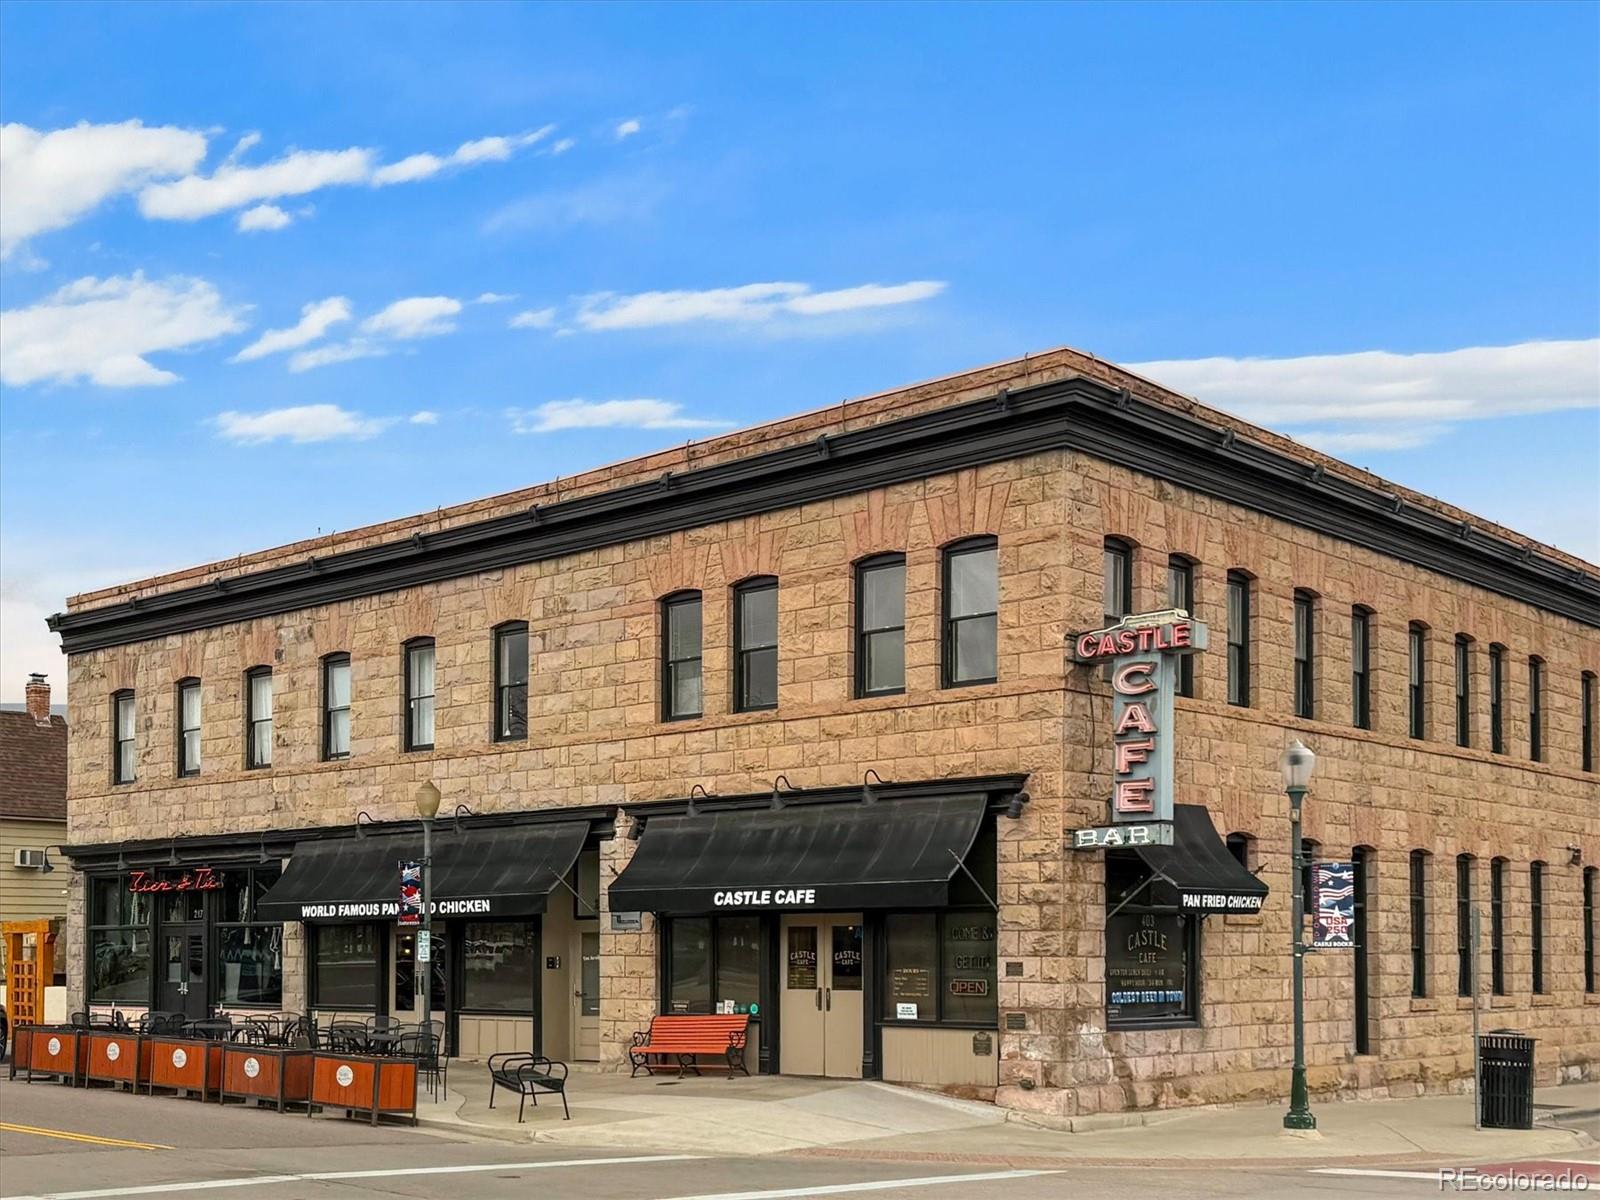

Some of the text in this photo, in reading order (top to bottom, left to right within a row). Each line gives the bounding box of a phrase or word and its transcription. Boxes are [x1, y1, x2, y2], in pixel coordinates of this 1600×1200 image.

[1077, 621, 1191, 658] CASTLE
[1112, 661, 1158, 813] CAFE
[1075, 825, 1151, 847] BAR
[713, 889, 816, 906] CASTLE CAFE
[1182, 894, 1262, 909] PAN FRIED CHICKEN
[301, 904, 337, 918] WORLD
[338, 903, 380, 917] FAMOUS
[439, 899, 490, 914] CHICKEN
[1142, 914, 1155, 927] 403
[1326, 916, 1348, 925] USA
[1327, 925, 1349, 934] 250
[1128, 930, 1168, 951] CASTLE
[790, 950, 816, 961] CASTLE
[834, 950, 861, 961] CASTLE
[1139, 952, 1157, 964] CAFE
[950, 981, 985, 994] OPEN
